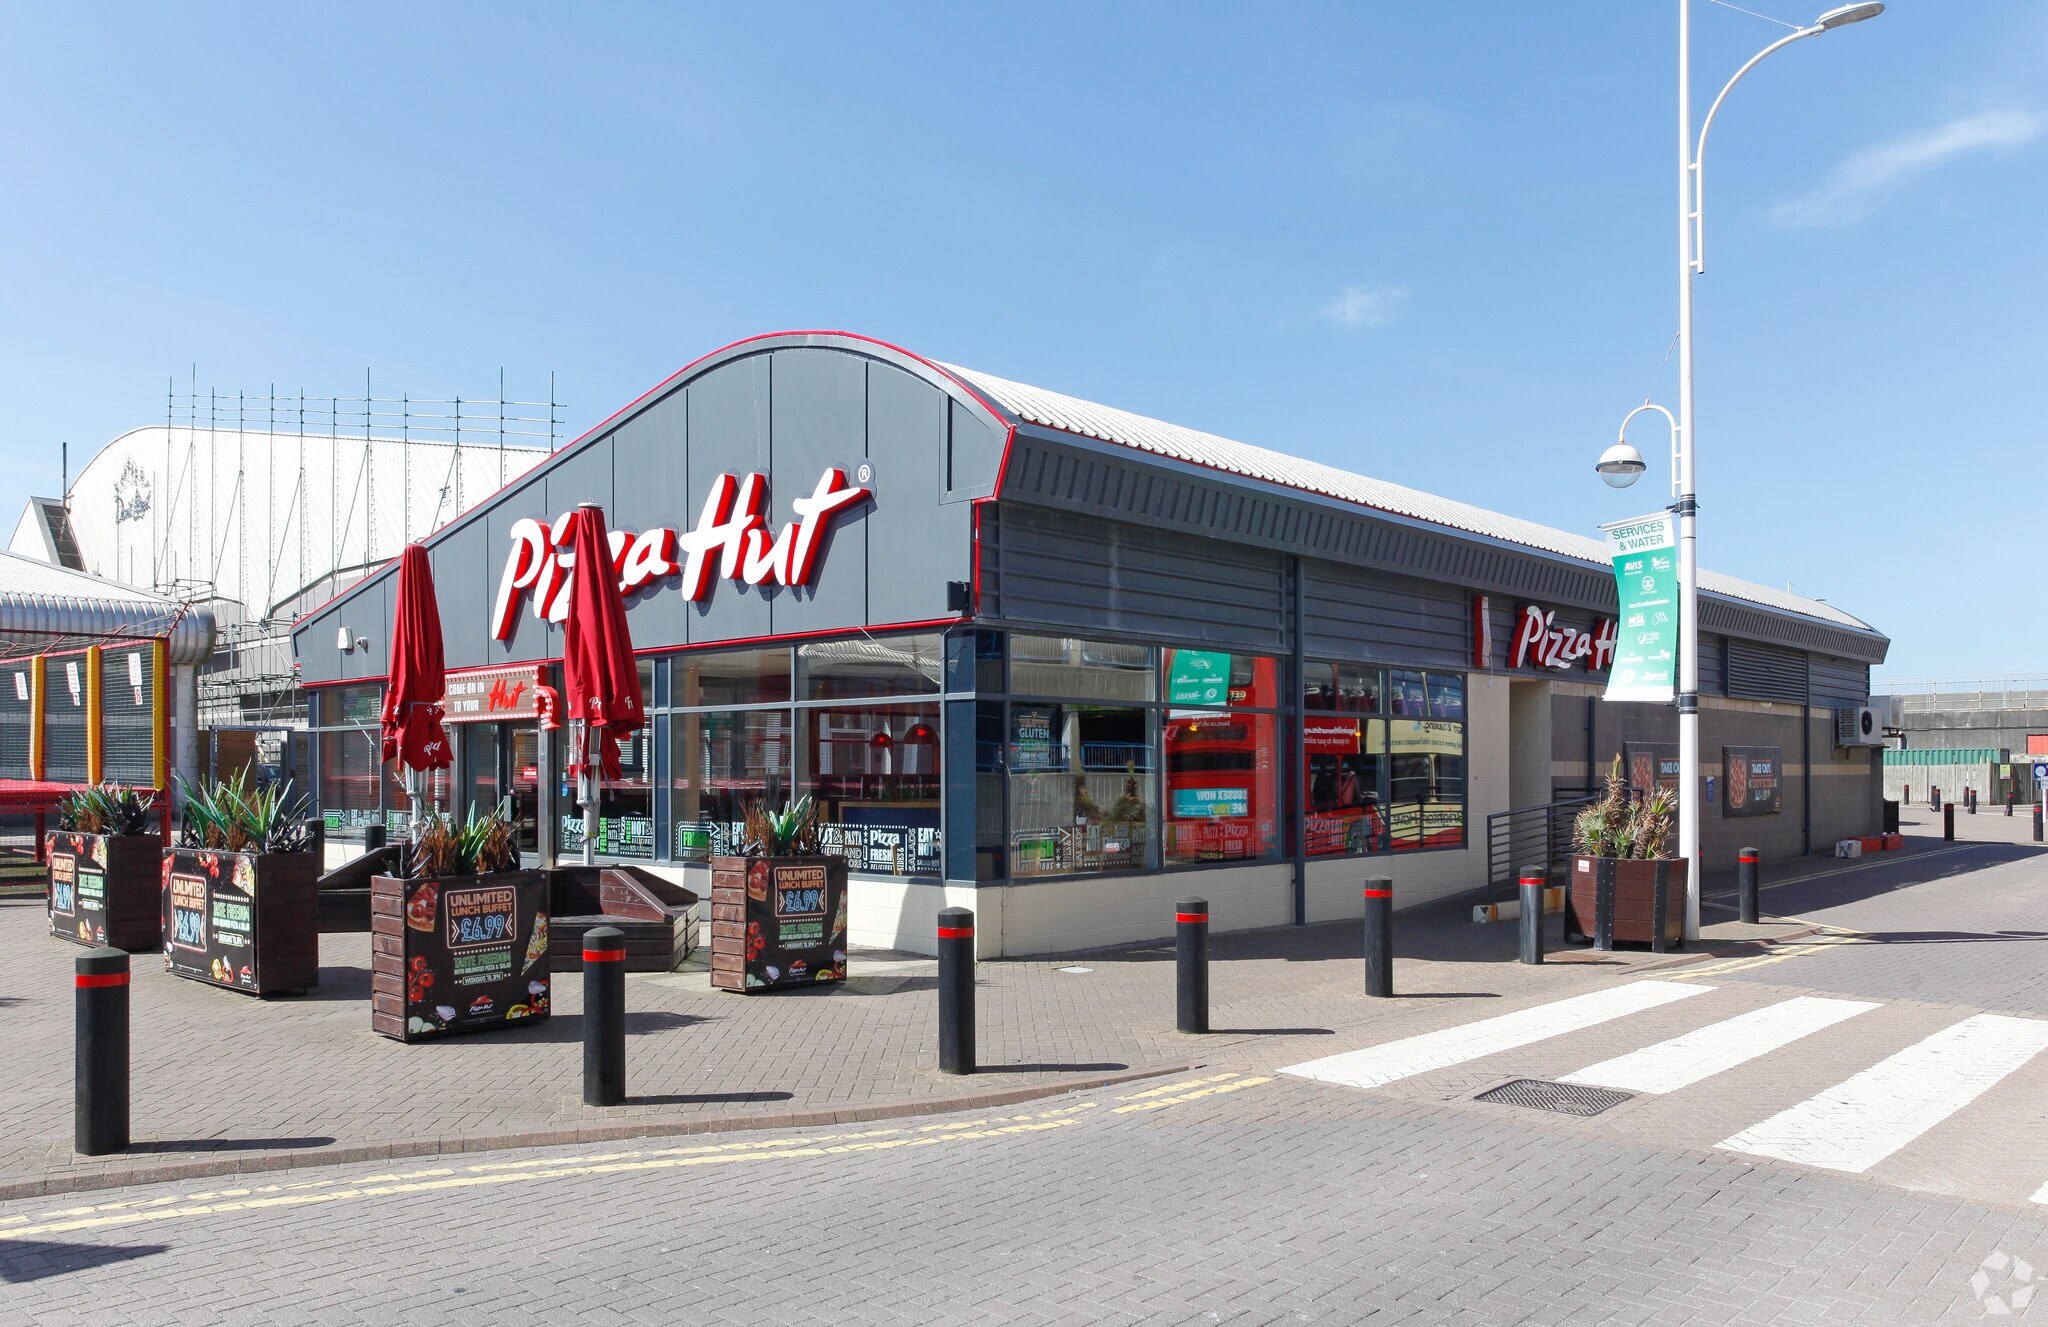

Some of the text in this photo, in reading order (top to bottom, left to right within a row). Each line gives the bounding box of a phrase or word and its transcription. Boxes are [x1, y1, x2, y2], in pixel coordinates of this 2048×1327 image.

[679, 467, 869, 602] Hut
[1612, 521, 1665, 540] SERVICES
[1619, 534, 1665, 551] & WATER
[1624, 560, 1643, 571] AVIS
[1628, 614, 1645, 625] MSL
[1517, 605, 1593, 669] Pizza
[449, 681, 485, 696] COME ON IN
[488, 678, 528, 712] Hut
[454, 699, 480, 712] TO YOUR
[1019, 728, 1050, 739] GLUTEN
[1661, 761, 1674, 773] TAKE
[631, 820, 646, 836] HOT
[918, 828, 935, 842] EAT
[1176, 825, 1194, 840] HOT
[1203, 826, 1218, 840] PASTA
[1225, 823, 1249, 838] Pizza
[845, 831, 862, 845] PASTA
[870, 828, 900, 846] Pizza
[908, 828, 916, 872] SALADS
[918, 843, 934, 856] HOT
[1075, 826, 1083, 868] SALADS
[1225, 840, 1243, 851] FRESH
[870, 849, 893, 861] FRESH
[778, 869, 824, 880] UNLIMITED
[173, 878, 205, 898] UNLIMITED
[779, 879, 824, 889] LUNCH BUFFET
[173, 894, 205, 910] LUNCH BUFFET
[450, 890, 513, 907] UNLIMITED
[785, 890, 819, 912] £6.99
[227, 902, 251, 922] FREEDOM
[451, 902, 513, 917] LUNCH BUFFET
[177, 909, 201, 944] £6.99
[460, 914, 505, 942] £6.99
[780, 922, 823, 934] TASTE FREEDOM
[454, 951, 511, 968] TASTE FREEDOM
[465, 965, 484, 974] UNLIMITED
[465, 975, 486, 984] WEEKDAYS
